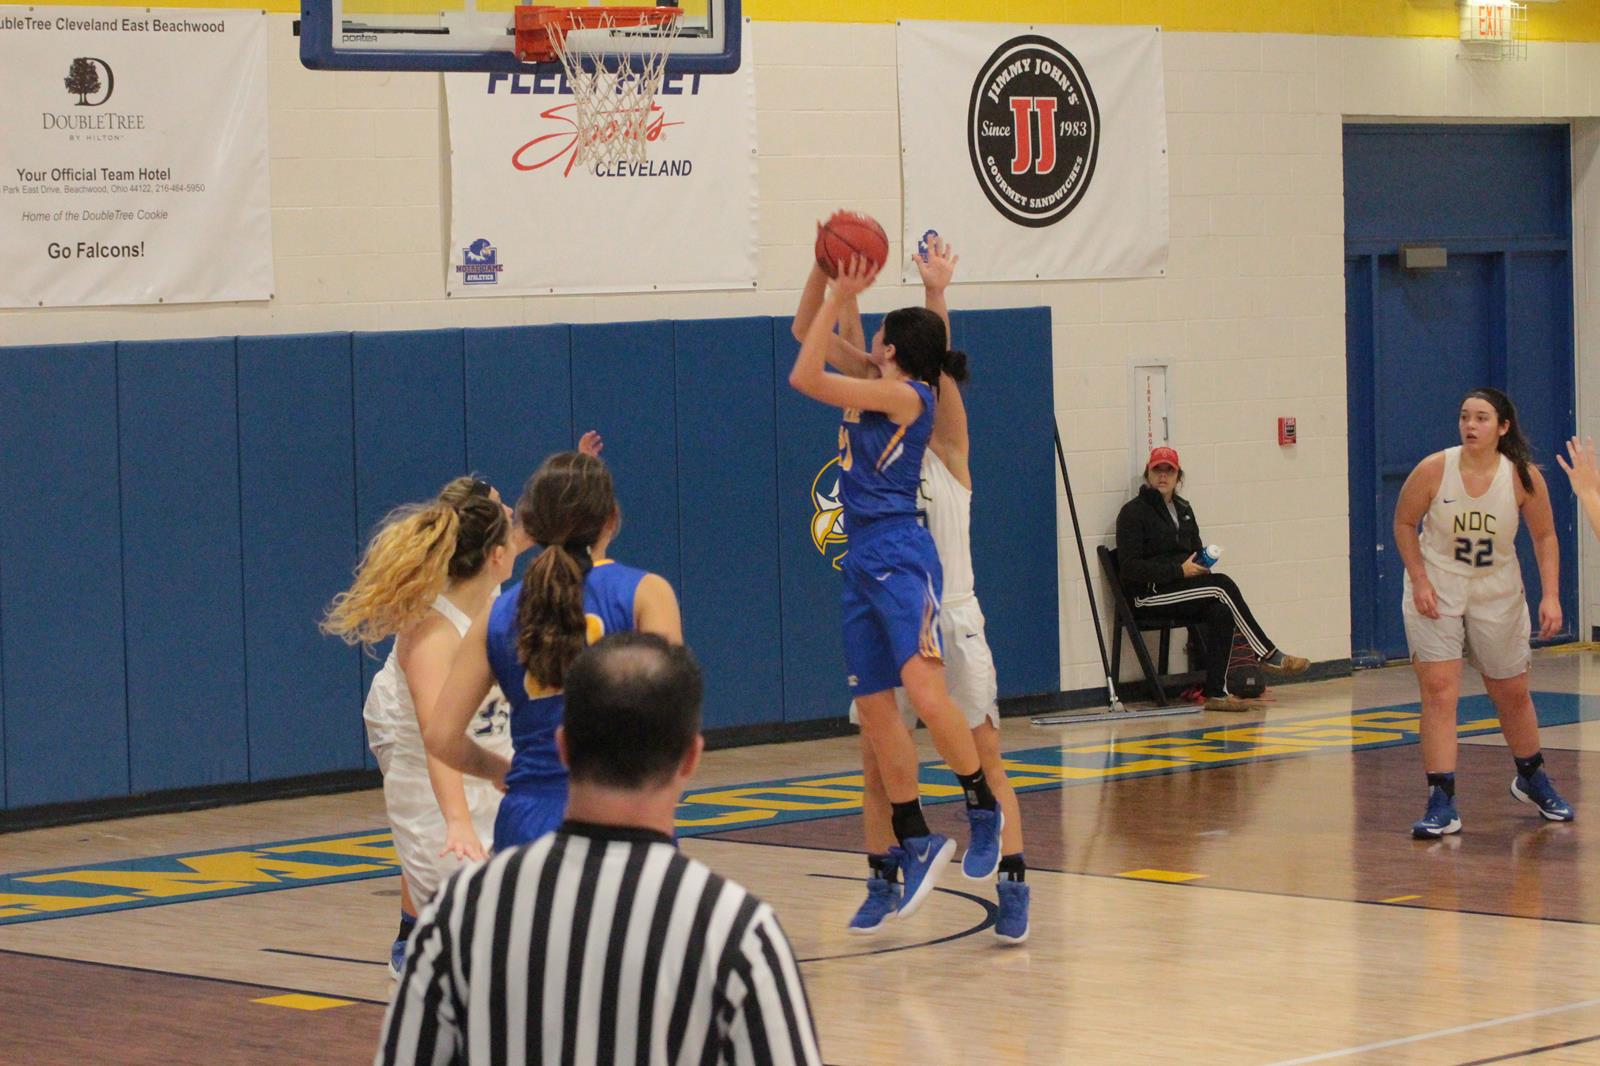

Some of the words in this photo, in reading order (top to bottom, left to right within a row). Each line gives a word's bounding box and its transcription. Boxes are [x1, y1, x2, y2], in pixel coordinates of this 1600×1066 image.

[56, 17, 118, 31] Cleveland
[122, 19, 150, 32] East
[153, 19, 225, 33] Beachwood
[1478, 5, 1503, 36] EXIT
[487, 73, 600, 95] FLEE
[987, 58, 1031, 104] JIMMY
[1035, 58, 1079, 106] JOHN'S
[981, 120, 1011, 136] Since
[1009, 96, 1058, 175] JJ
[1059, 121, 1088, 137] 1983
[17, 168, 47, 181] Your
[51, 168, 97, 181] Official
[101, 168, 135, 181] Team
[138, 167, 171, 180] Hotel
[595, 160, 693, 177] CLEVELAND
[2, 185, 20, 194] Park
[22, 185, 39, 194] East
[111, 184, 128, 193] Ohio
[987, 155, 1027, 207] GOURMET
[1029, 155, 1083, 208] SANDWICHES
[22, 211, 50, 221] Home
[53, 210, 63, 221] of
[65, 211, 79, 221] the
[82, 209, 134, 221] DoubleTree
[137, 209, 168, 220] Cookie
[48, 242, 71, 259] Go
[77, 241, 145, 258] Falcons!
[1453, 511, 1497, 535] NDC
[1454, 537, 1494, 568] 22
